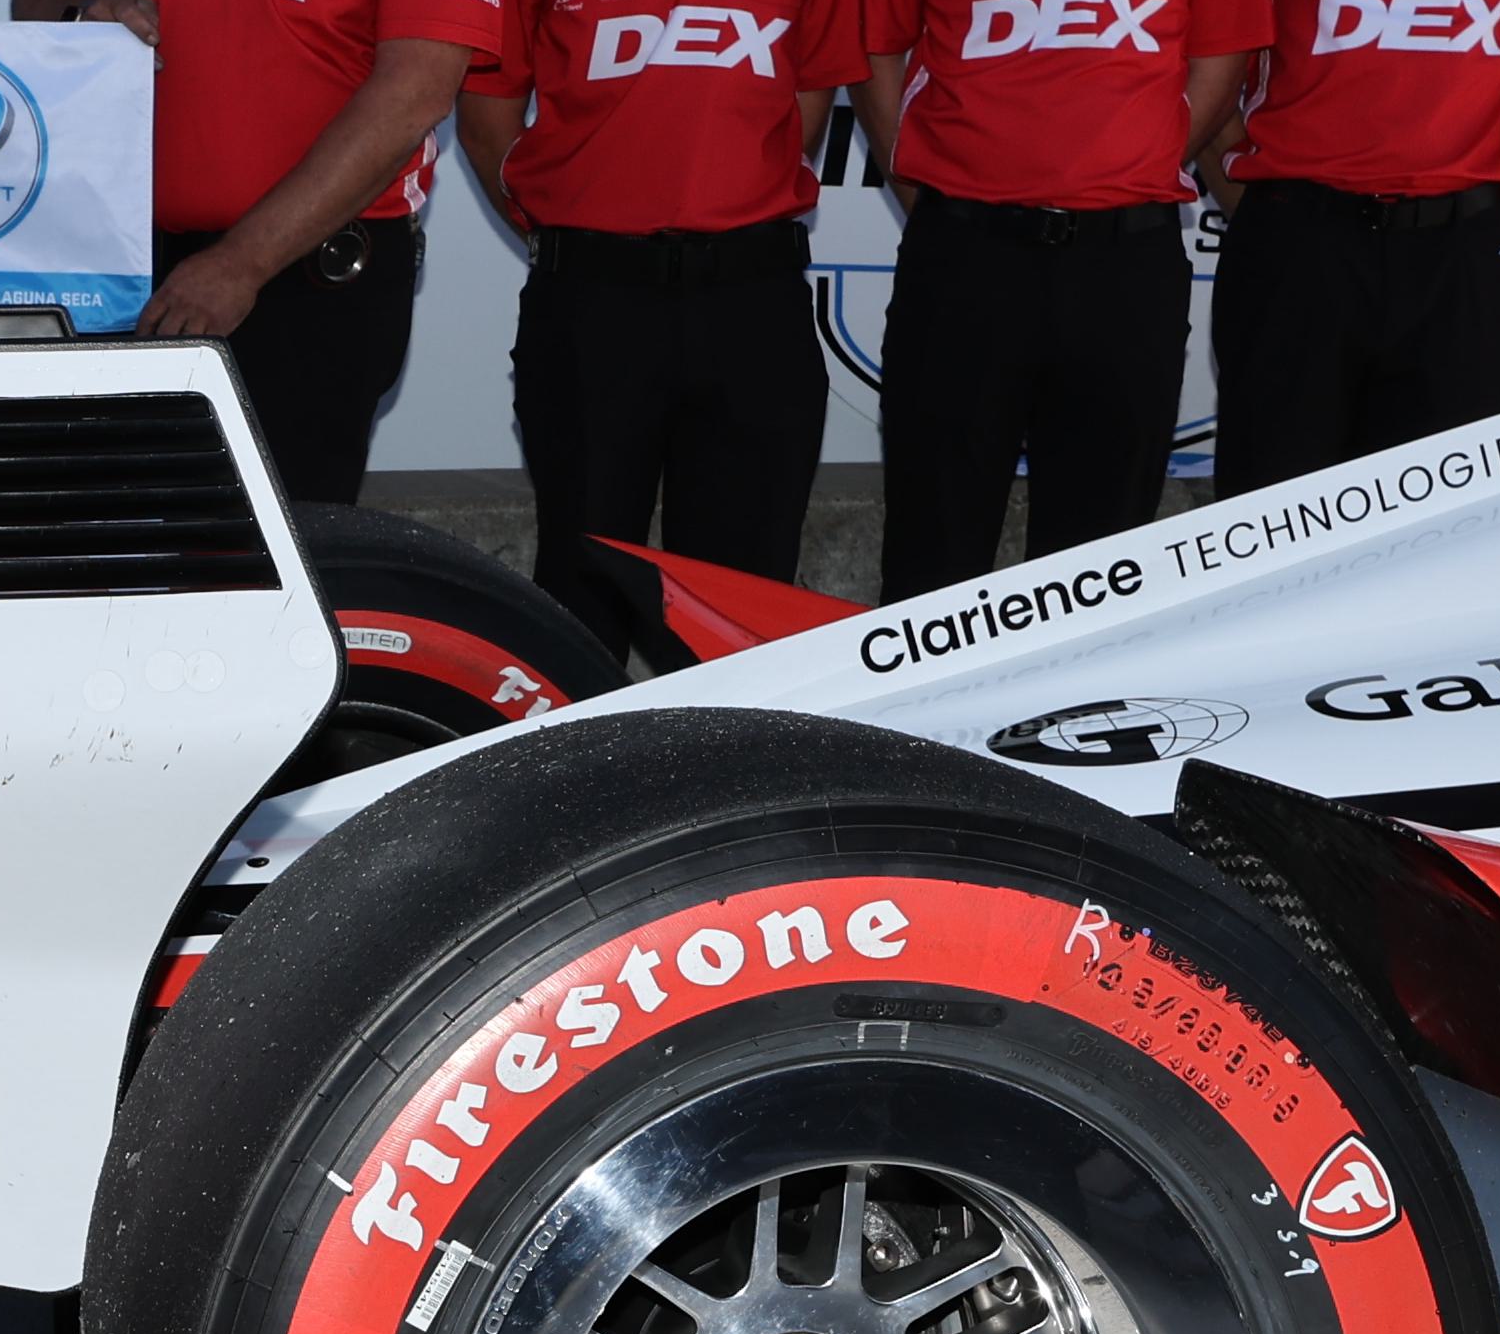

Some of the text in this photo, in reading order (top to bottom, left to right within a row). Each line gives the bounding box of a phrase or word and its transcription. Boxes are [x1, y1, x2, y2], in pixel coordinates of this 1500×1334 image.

[587, 4, 792, 81] DEX
[60, 291, 103, 308] SECA
[858, 550, 1145, 676] Clarience
[351, 898, 911, 1253] Firestone
